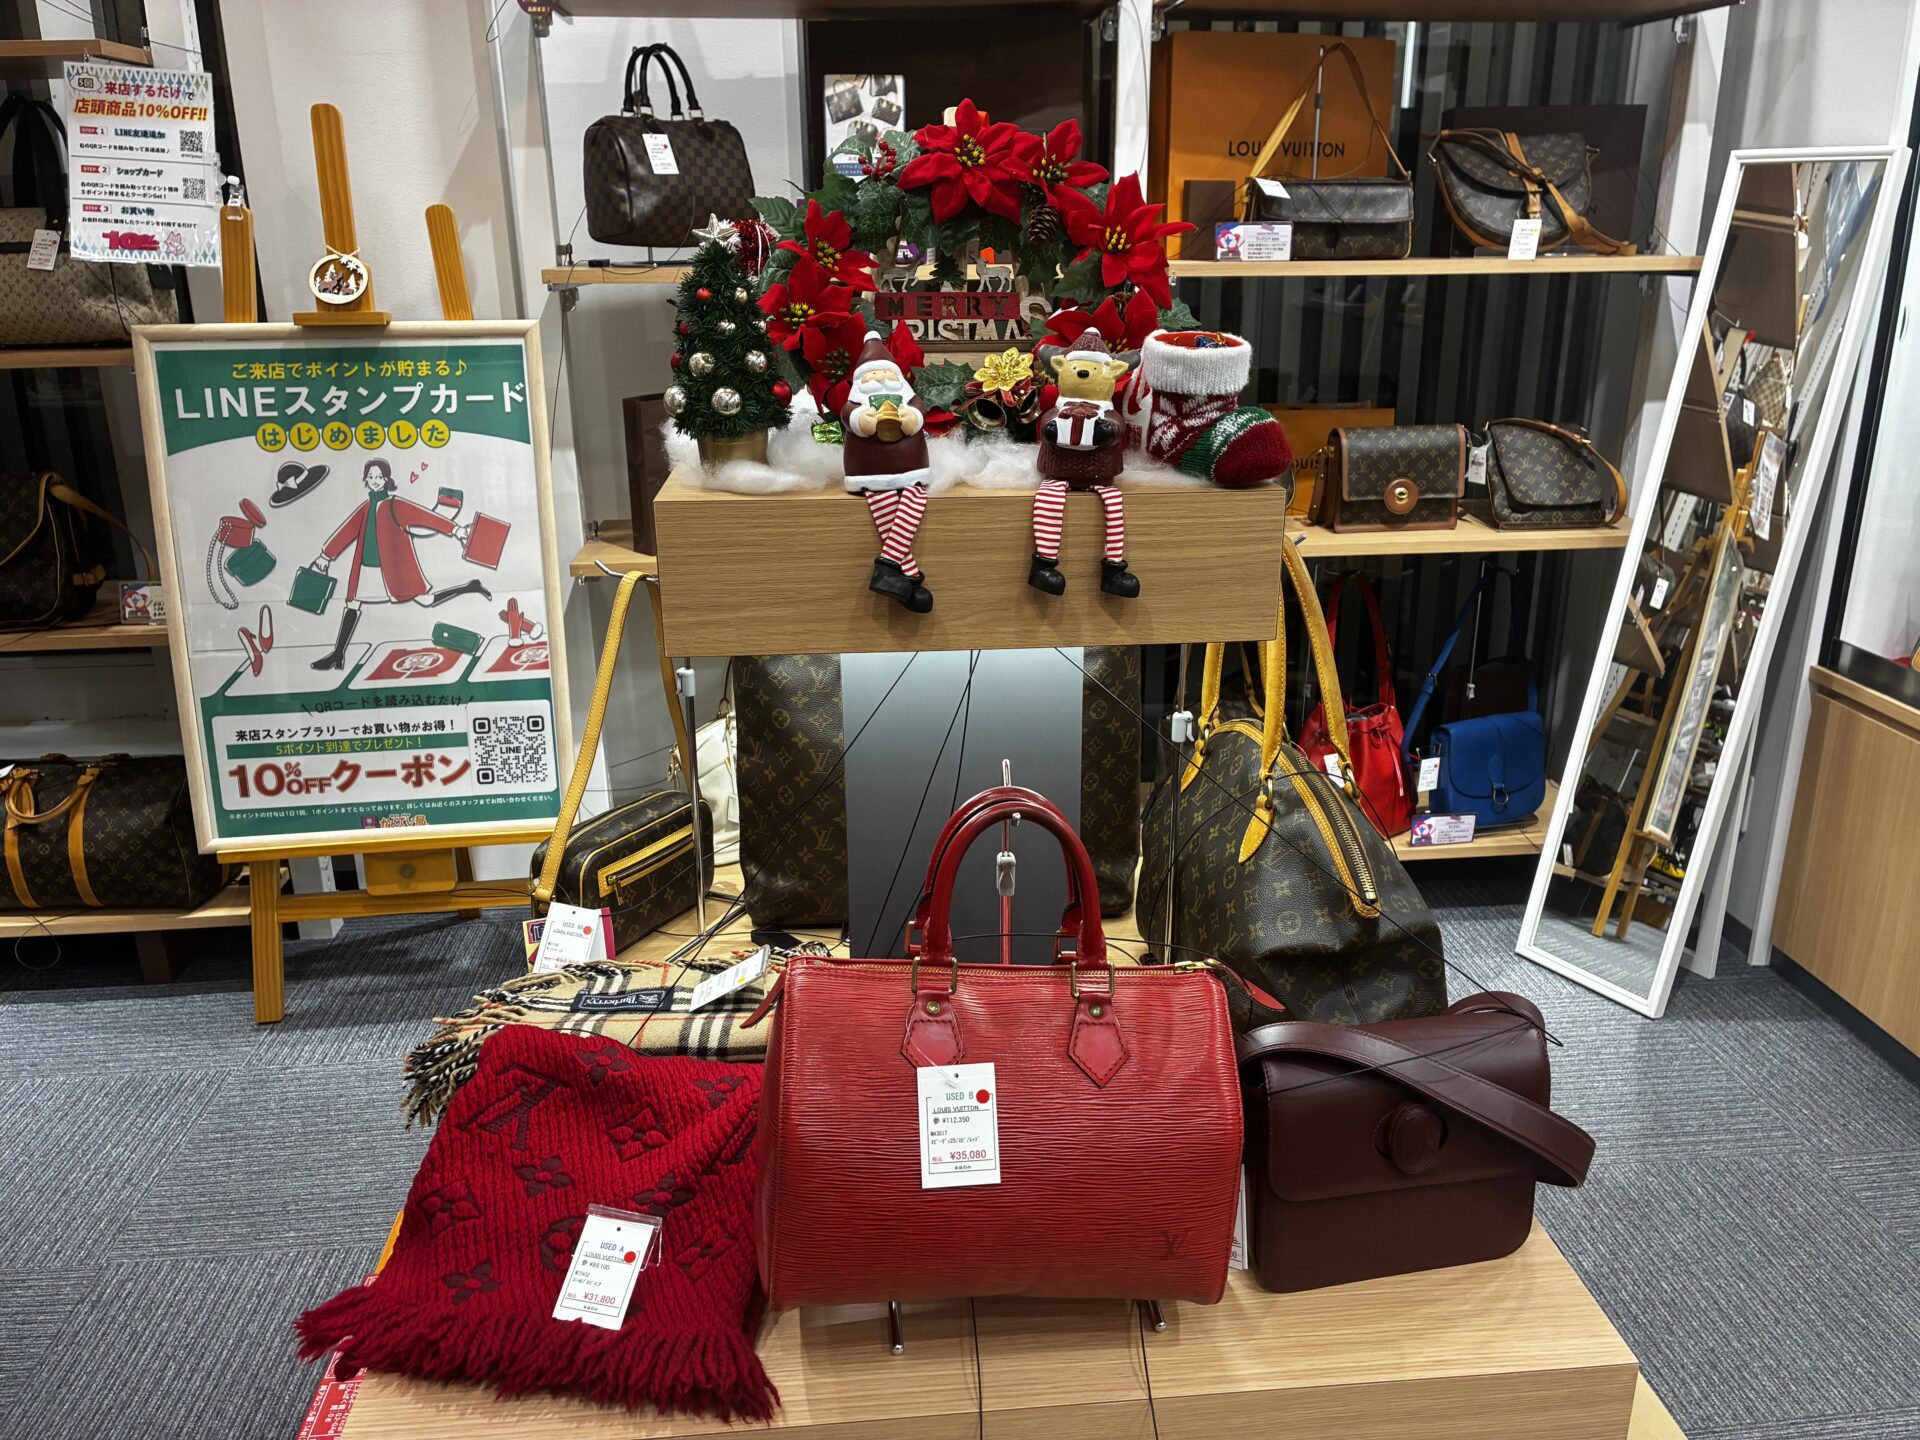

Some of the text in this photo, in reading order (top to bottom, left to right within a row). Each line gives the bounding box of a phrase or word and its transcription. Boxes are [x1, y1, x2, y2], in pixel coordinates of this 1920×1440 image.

[77, 77, 195, 100] 5回 来店するだけで
[74, 98, 208, 121] 店頭商品10%OFF!!
[114, 128, 166, 139] LINE友達追加
[1229, 140, 1278, 157] LOU
[116, 167, 164, 178] ショップカード
[120, 206, 155, 216] お買い物
[887, 295, 1009, 317] MERRY
[175, 380, 526, 420] LINEスタンプカード
[259, 422, 449, 450] はじめました
[316, 693, 463, 715] QRコードを読み込むだけ
[235, 719, 455, 742] 来店スタンプラリーでお買い物がお得！
[275, 736, 422, 757] 5ポイント到達でプレゼント！
[500, 746, 521, 755] LINE
[946, 1091, 974, 1101] USED B
[950, 1149, 987, 1160] ¥35,080
[599, 1241, 617, 1251] USED
[584, 1250, 602, 1258] LOUIS
[583, 1291, 616, 1305] ¥31,800
